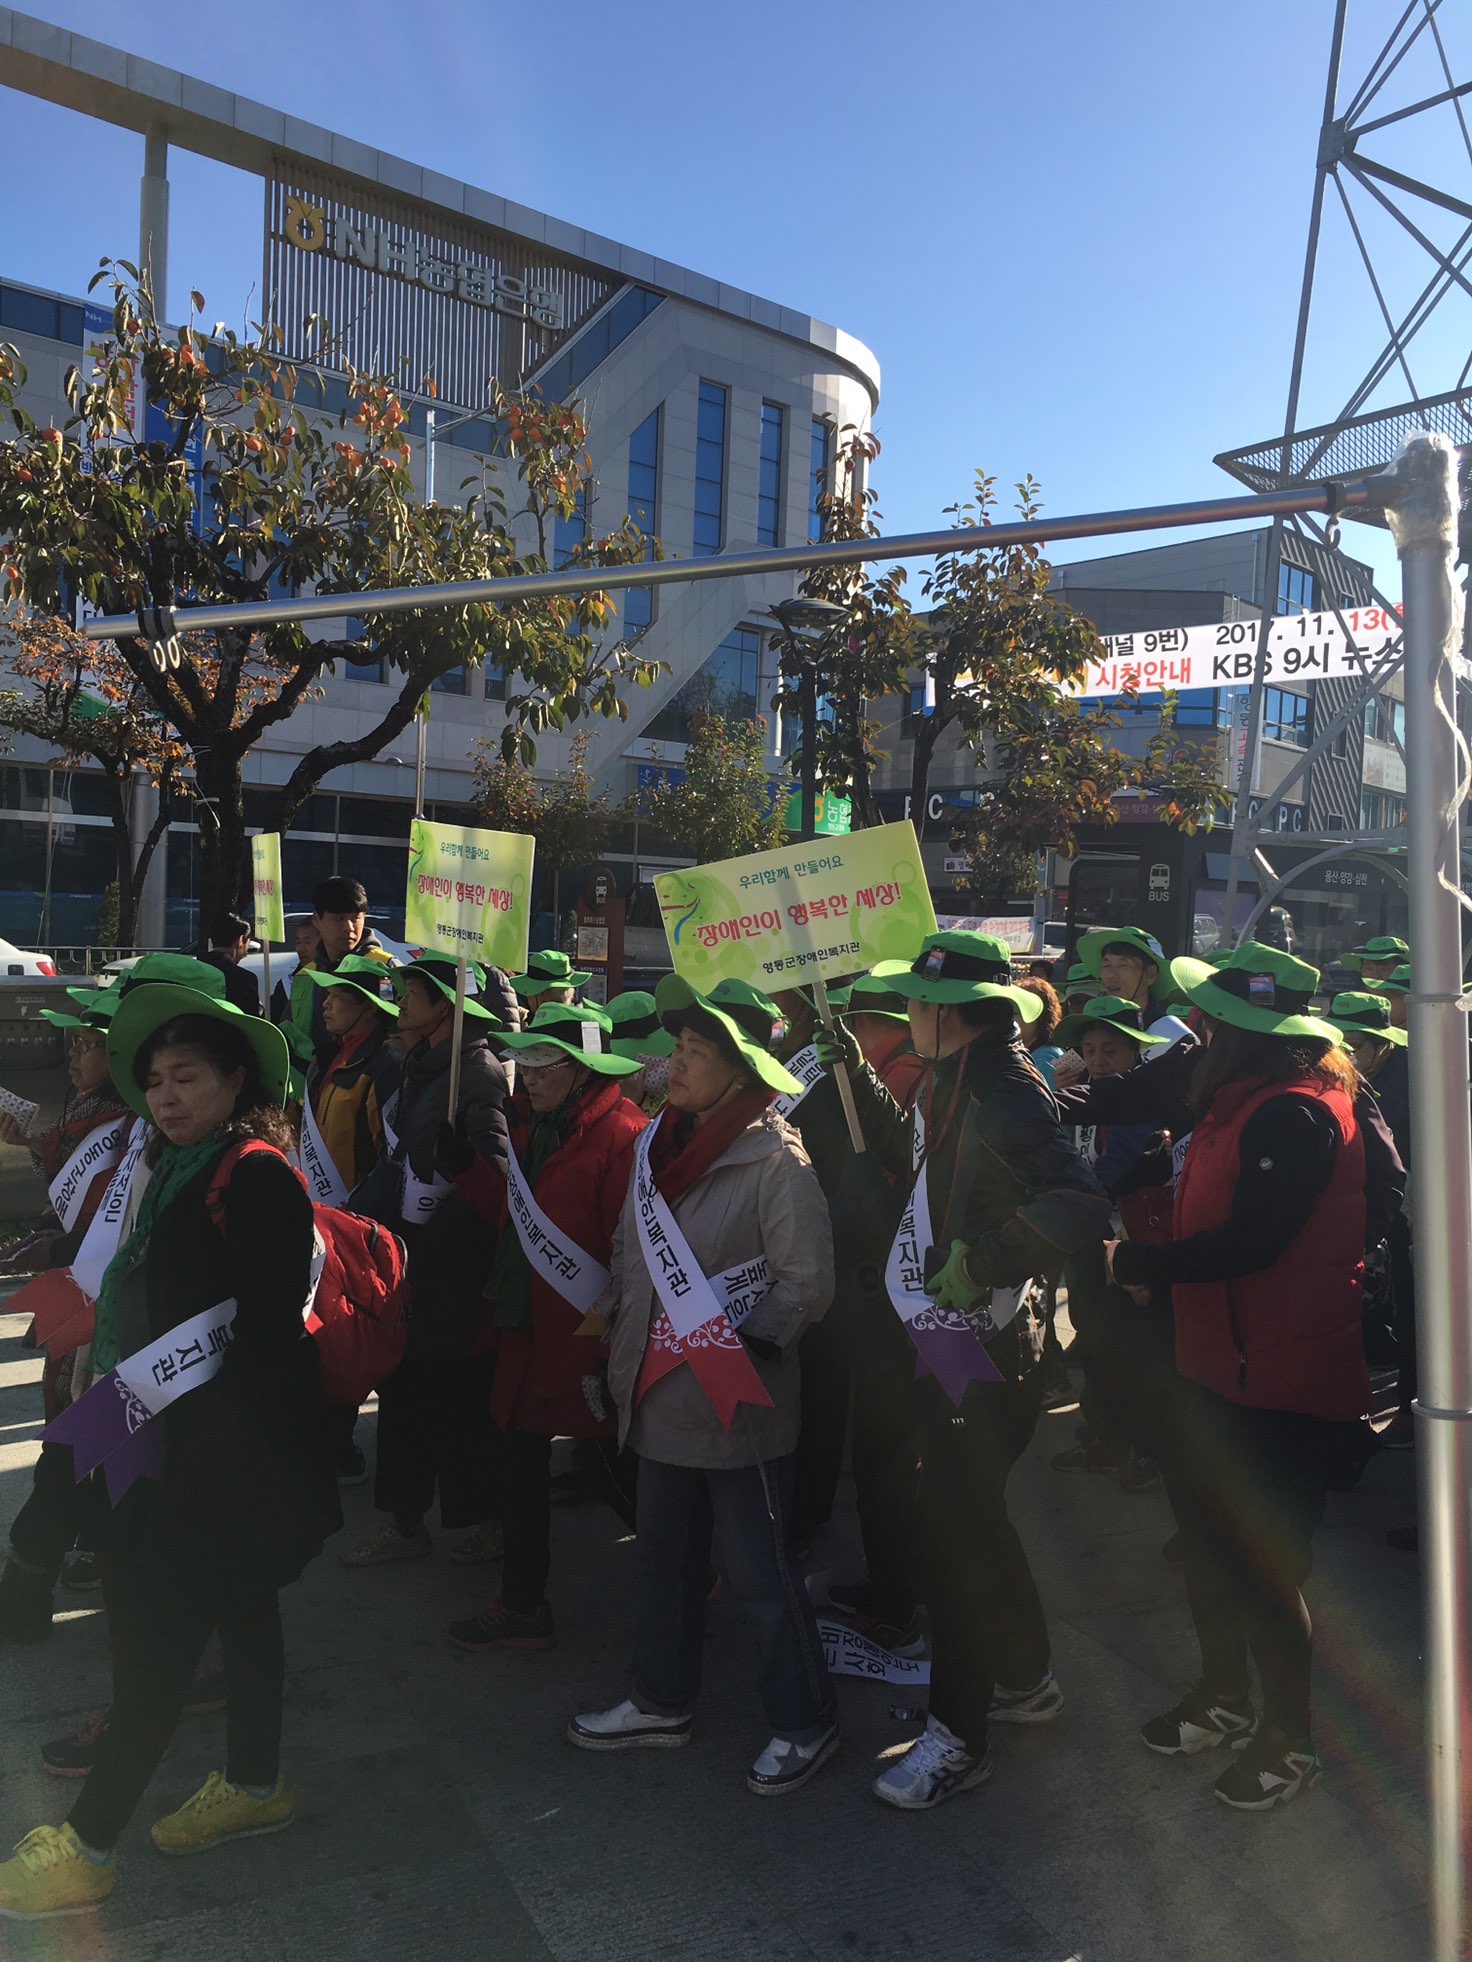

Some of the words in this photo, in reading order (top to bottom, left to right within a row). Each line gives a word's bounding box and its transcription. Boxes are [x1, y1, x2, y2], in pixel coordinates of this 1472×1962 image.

[335, 216, 563, 330] NH농협은행
[85, 310, 102, 323] NH
[1297, 615, 1334, 637] 11.
[1095, 657, 1191, 690] 시청안내
[1212, 652, 1273, 681] KBS
[1283, 642, 1330, 674] 9시
[827, 801, 851, 824] 농협
[439, 842, 464, 858] 우리함께
[464, 846, 490, 861] 만들어요
[739, 866, 790, 889] 우리함께
[794, 855, 844, 878] 만들어요
[417, 874, 453, 900] 장애인이
[455, 881, 486, 906] 행복한
[488, 888, 513, 912] 세상!
[1148, 890, 1170, 902] BUS
[696, 909, 783, 947] 장애인이
[787, 893, 849, 926] 행복한
[856, 881, 902, 909] 세상!
[762, 941, 861, 974] 영동군장애인복지관
